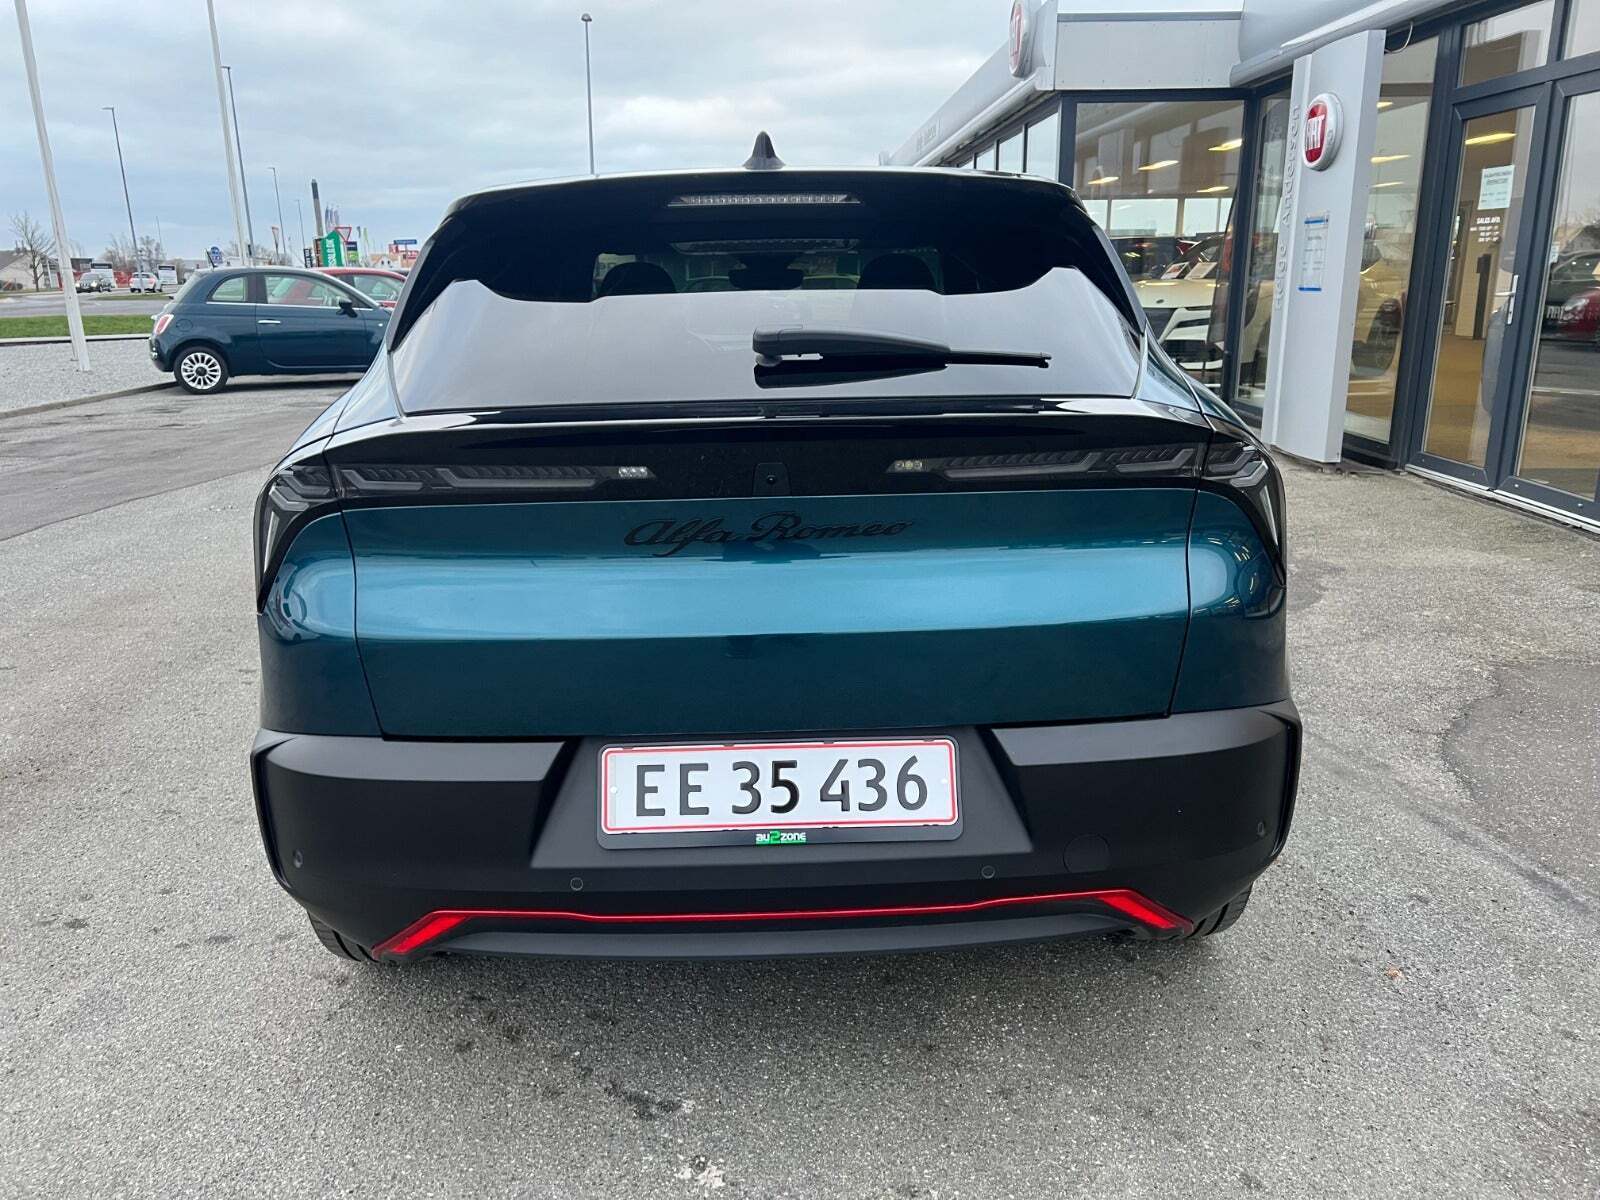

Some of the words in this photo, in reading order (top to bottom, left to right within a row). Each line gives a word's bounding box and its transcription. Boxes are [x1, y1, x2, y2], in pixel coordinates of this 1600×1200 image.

[1281, 105, 1300, 229] Andersen
[623, 517, 738, 558] Alfa
[738, 510, 914, 544] Romeo
[635, 762, 710, 818] EE
[731, 759, 800, 815] 35
[819, 755, 929, 812] 436
[755, 830, 807, 845] au2zone
